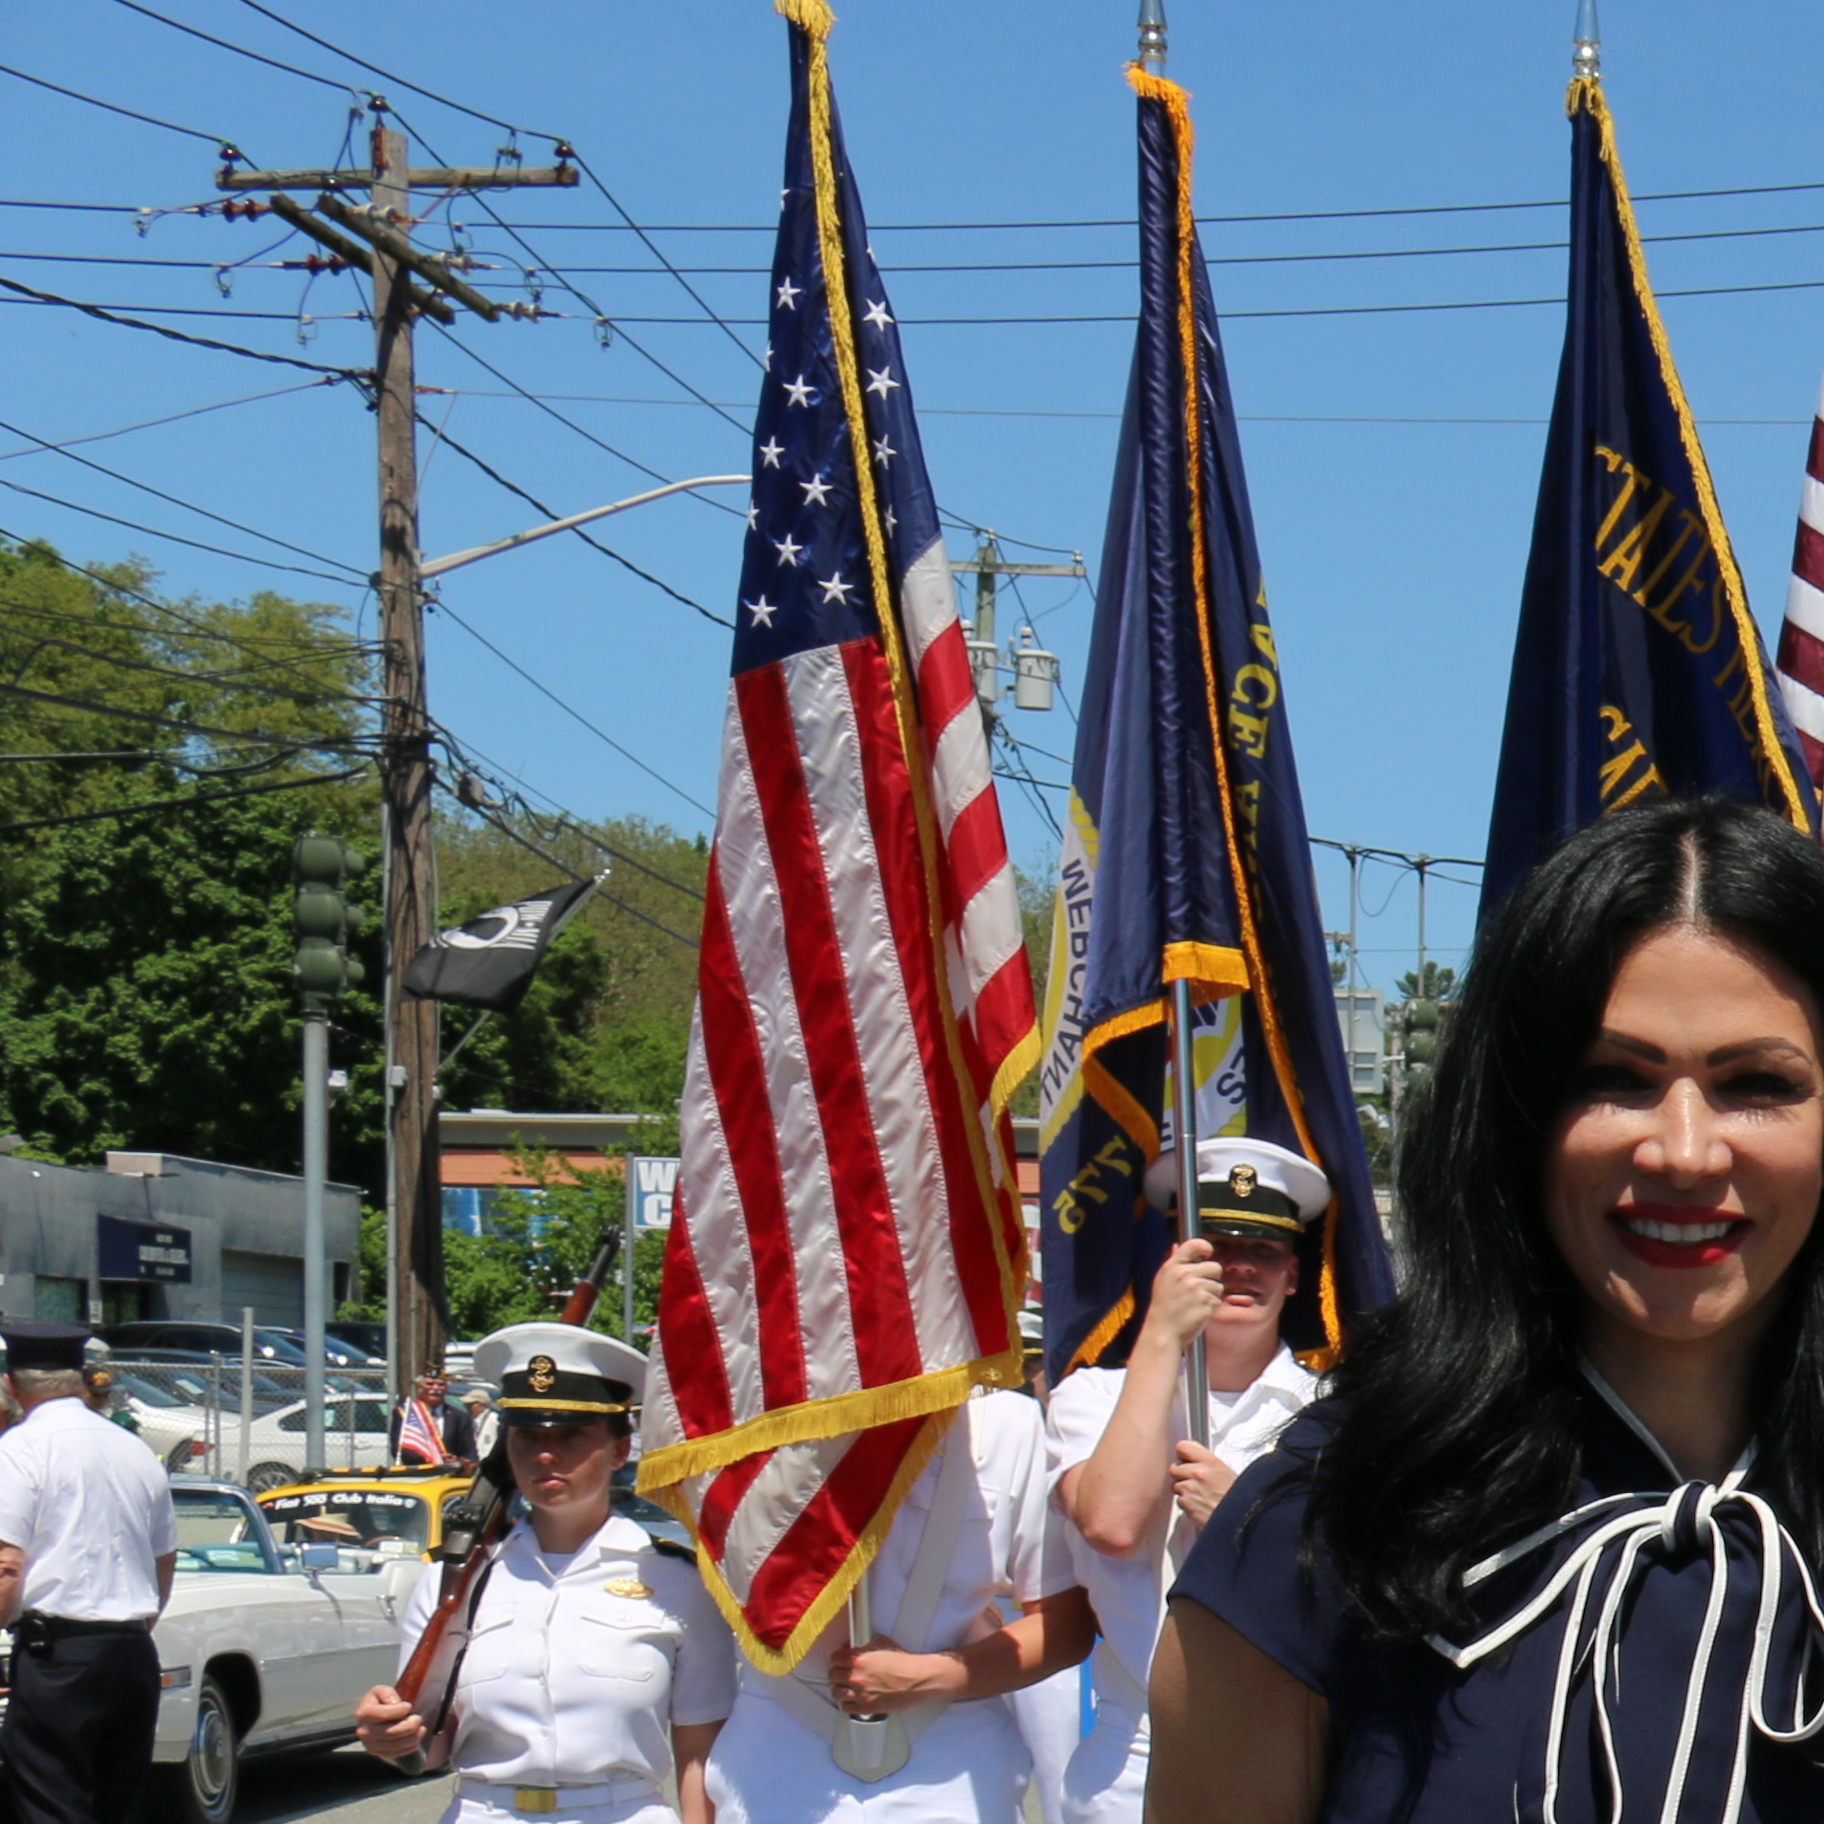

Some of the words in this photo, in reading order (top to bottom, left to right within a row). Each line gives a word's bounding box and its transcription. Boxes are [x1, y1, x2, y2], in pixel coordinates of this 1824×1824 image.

[274, 1497, 300, 1510] Fiat
[303, 1493, 328, 1506] 500
[331, 1492, 363, 1504] Club
[365, 1494, 404, 1506] Italia
